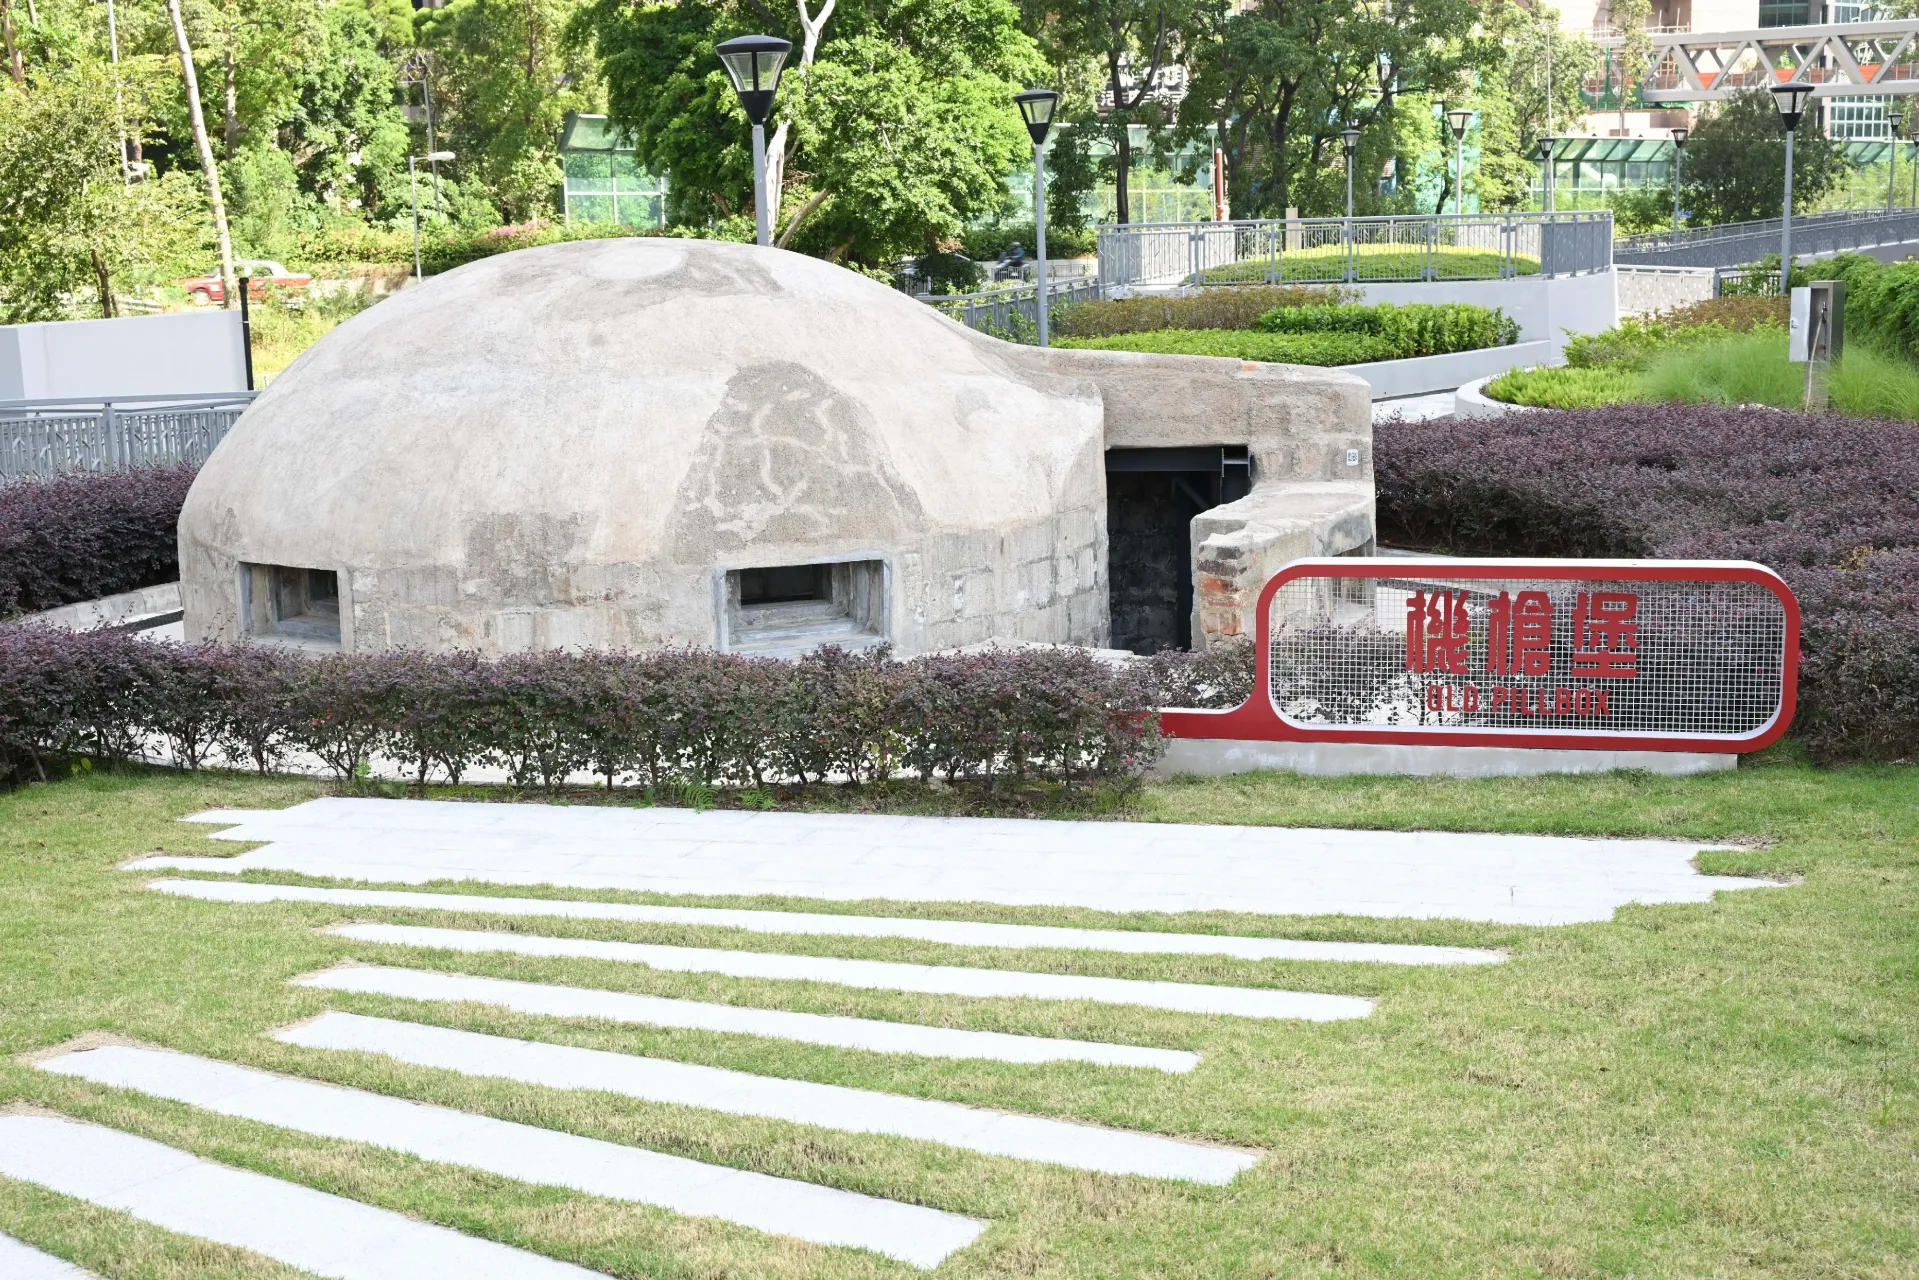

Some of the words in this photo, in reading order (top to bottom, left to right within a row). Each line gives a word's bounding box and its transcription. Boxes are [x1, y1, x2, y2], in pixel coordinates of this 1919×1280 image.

[1405, 590, 1638, 677] 機槍堡
[1427, 685, 1478, 712] OLD
[1492, 686, 1611, 716] PILLBOX
